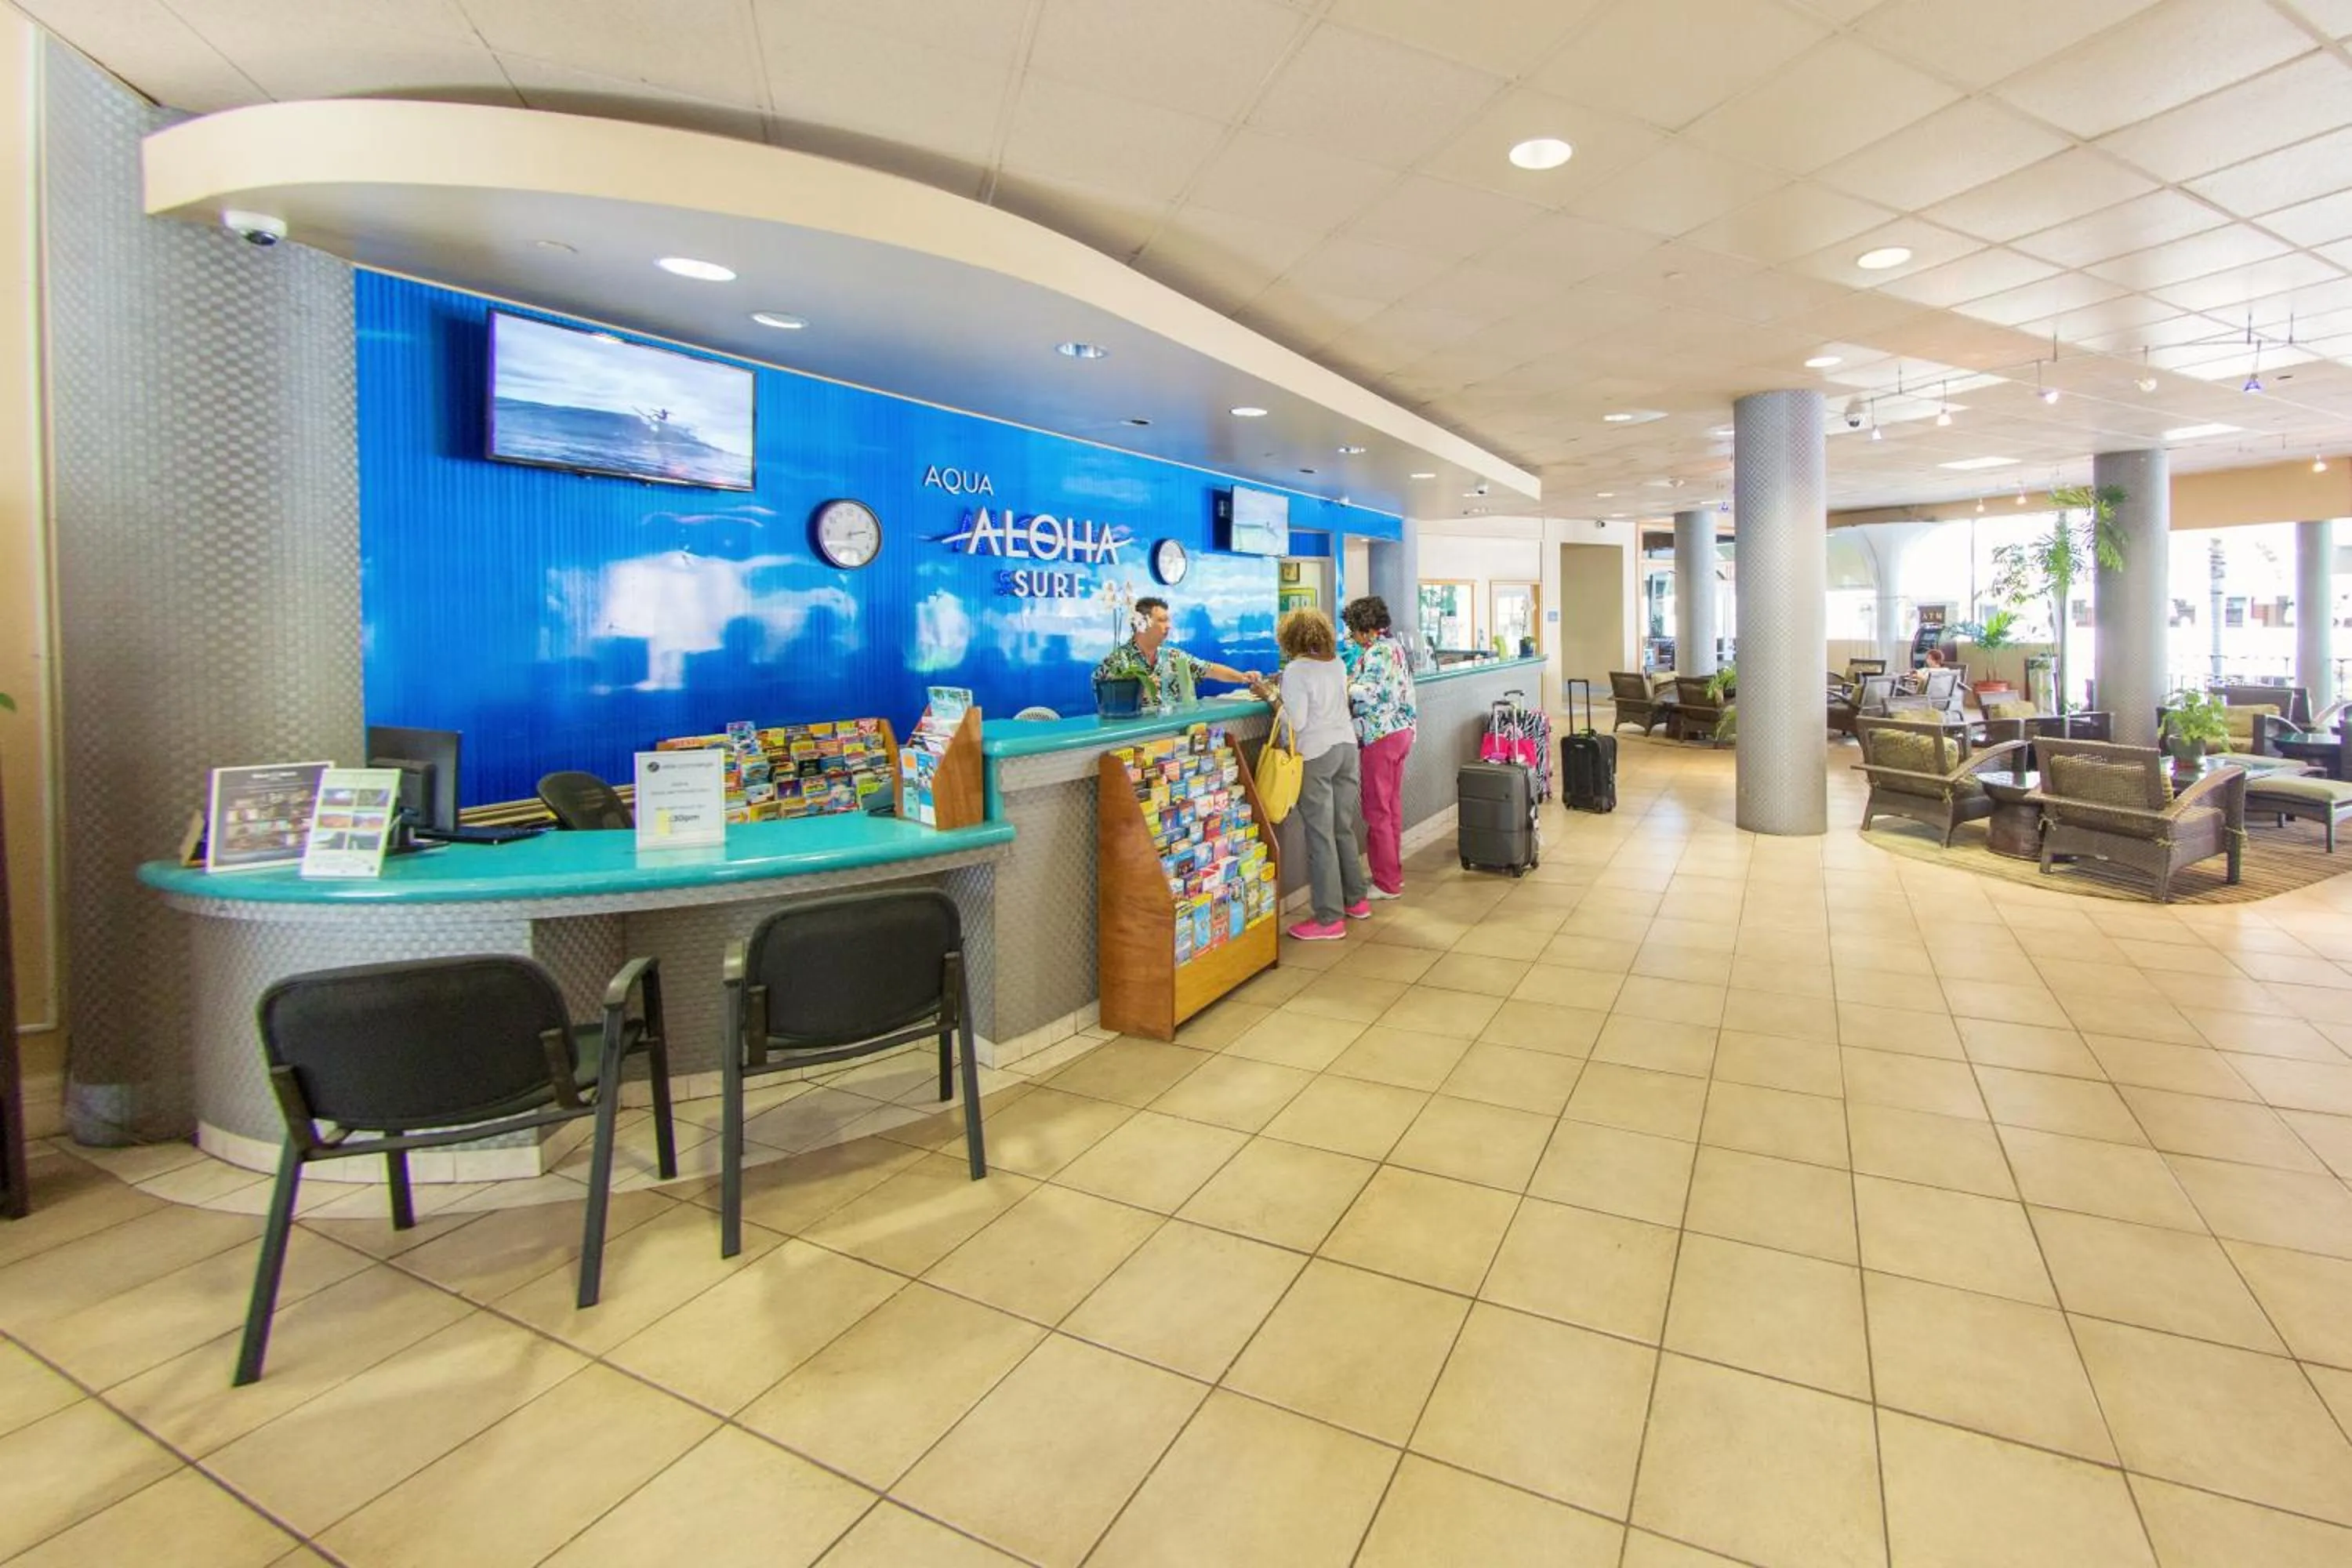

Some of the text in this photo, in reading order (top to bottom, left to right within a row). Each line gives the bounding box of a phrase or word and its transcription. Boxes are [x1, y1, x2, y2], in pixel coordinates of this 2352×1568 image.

[924, 466, 994, 495] AQUA
[967, 506, 1120, 565] ALOHA
[1013, 570, 1087, 598] SURF
[1922, 612, 1943, 621] ATM
